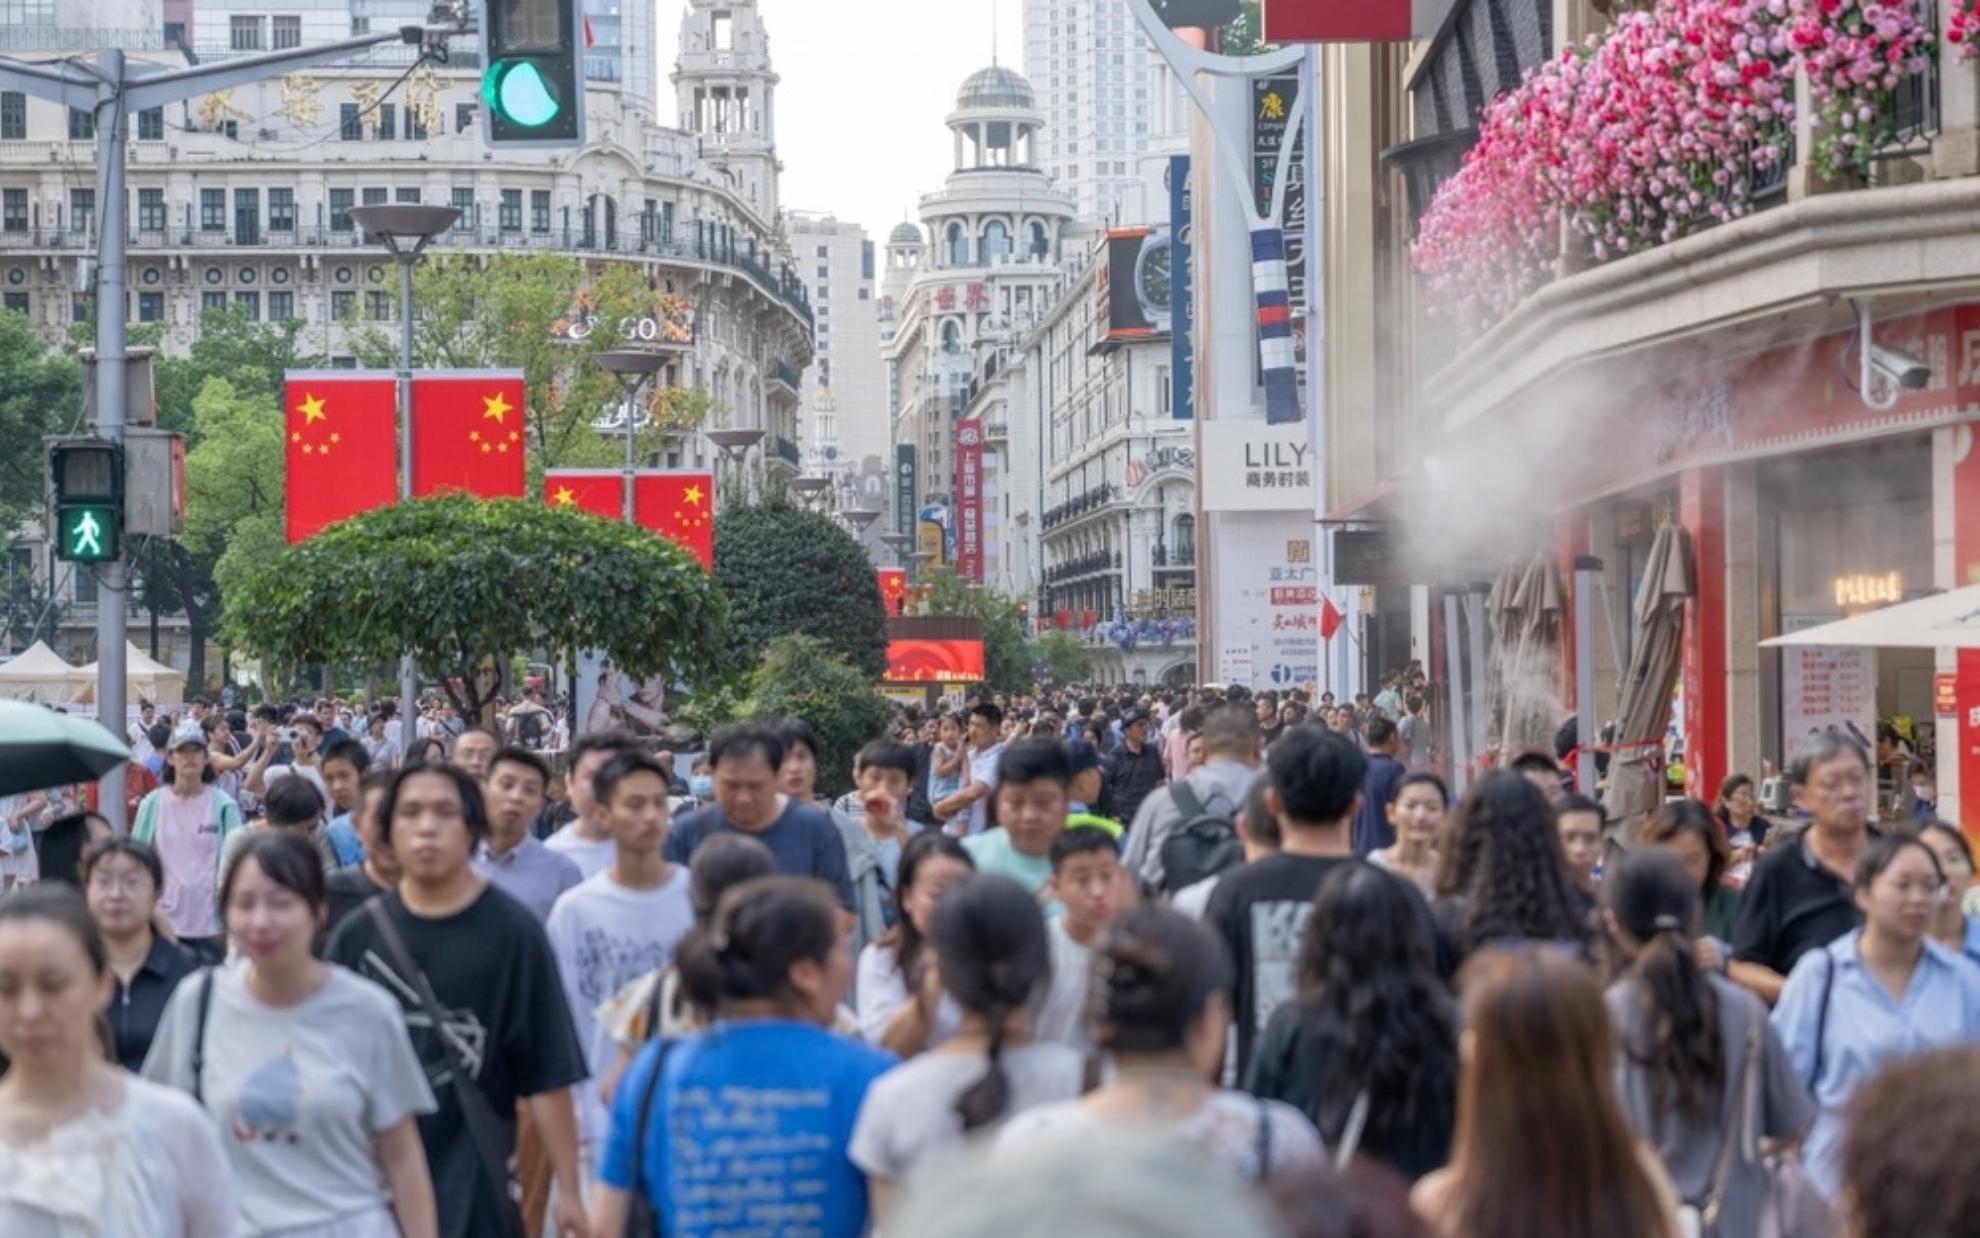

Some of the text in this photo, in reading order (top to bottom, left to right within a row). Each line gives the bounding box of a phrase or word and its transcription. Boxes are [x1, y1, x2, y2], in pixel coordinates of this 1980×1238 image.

[1246, 442, 1308, 468] LILY
[1246, 471, 1310, 489] 商务时装
